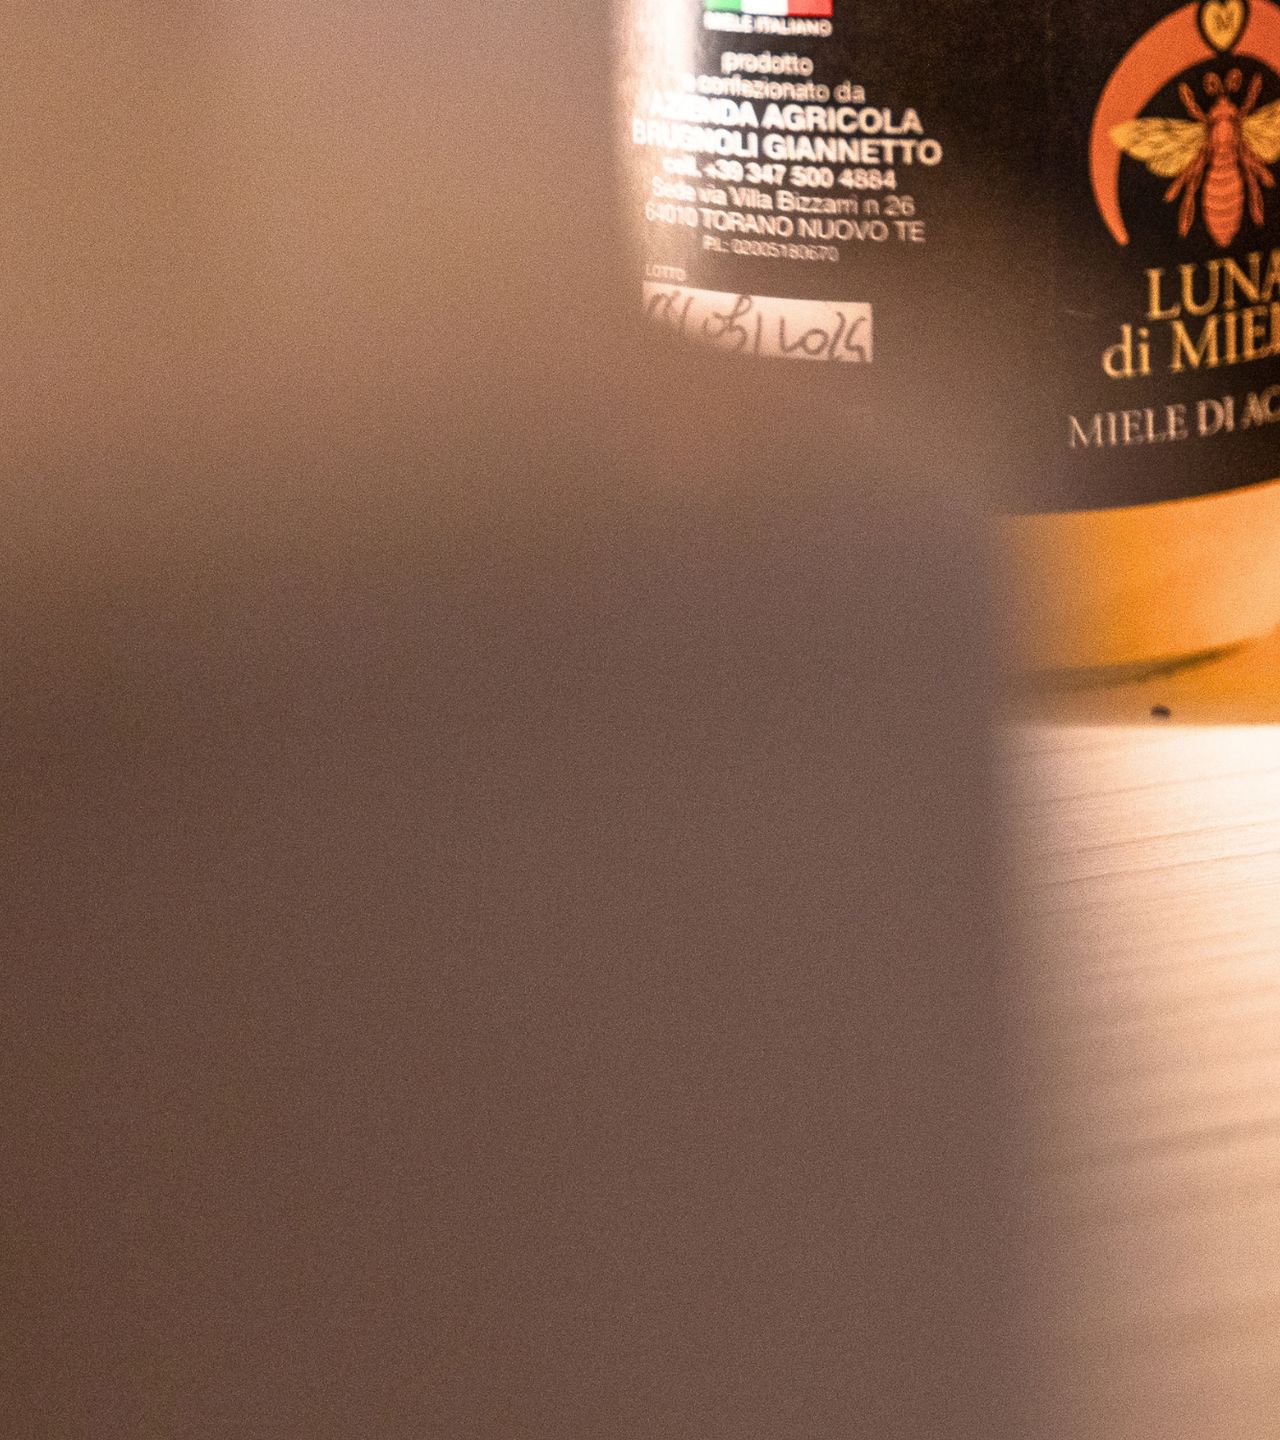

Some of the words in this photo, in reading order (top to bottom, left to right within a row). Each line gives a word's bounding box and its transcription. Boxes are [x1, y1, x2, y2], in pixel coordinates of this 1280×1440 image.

[721, 50, 814, 76] prodotto
[697, 74, 830, 102] confezionato
[834, 80, 865, 104] da
[762, 103, 923, 135] AGRICOLA
[763, 137, 942, 167] GIANNETTO
[745, 162, 787, 186] 347
[789, 165, 834, 188] 500
[838, 168, 897, 190] 4884
[728, 186, 772, 210] Villa
[883, 195, 915, 216] 26
[701, 209, 793, 238] TORANO
[798, 213, 889, 242] NUOVO
[897, 220, 925, 242] TE
[1103, 324, 1151, 379] di
[1068, 403, 1188, 449] MIELE
[1197, 395, 1235, 436] DI
